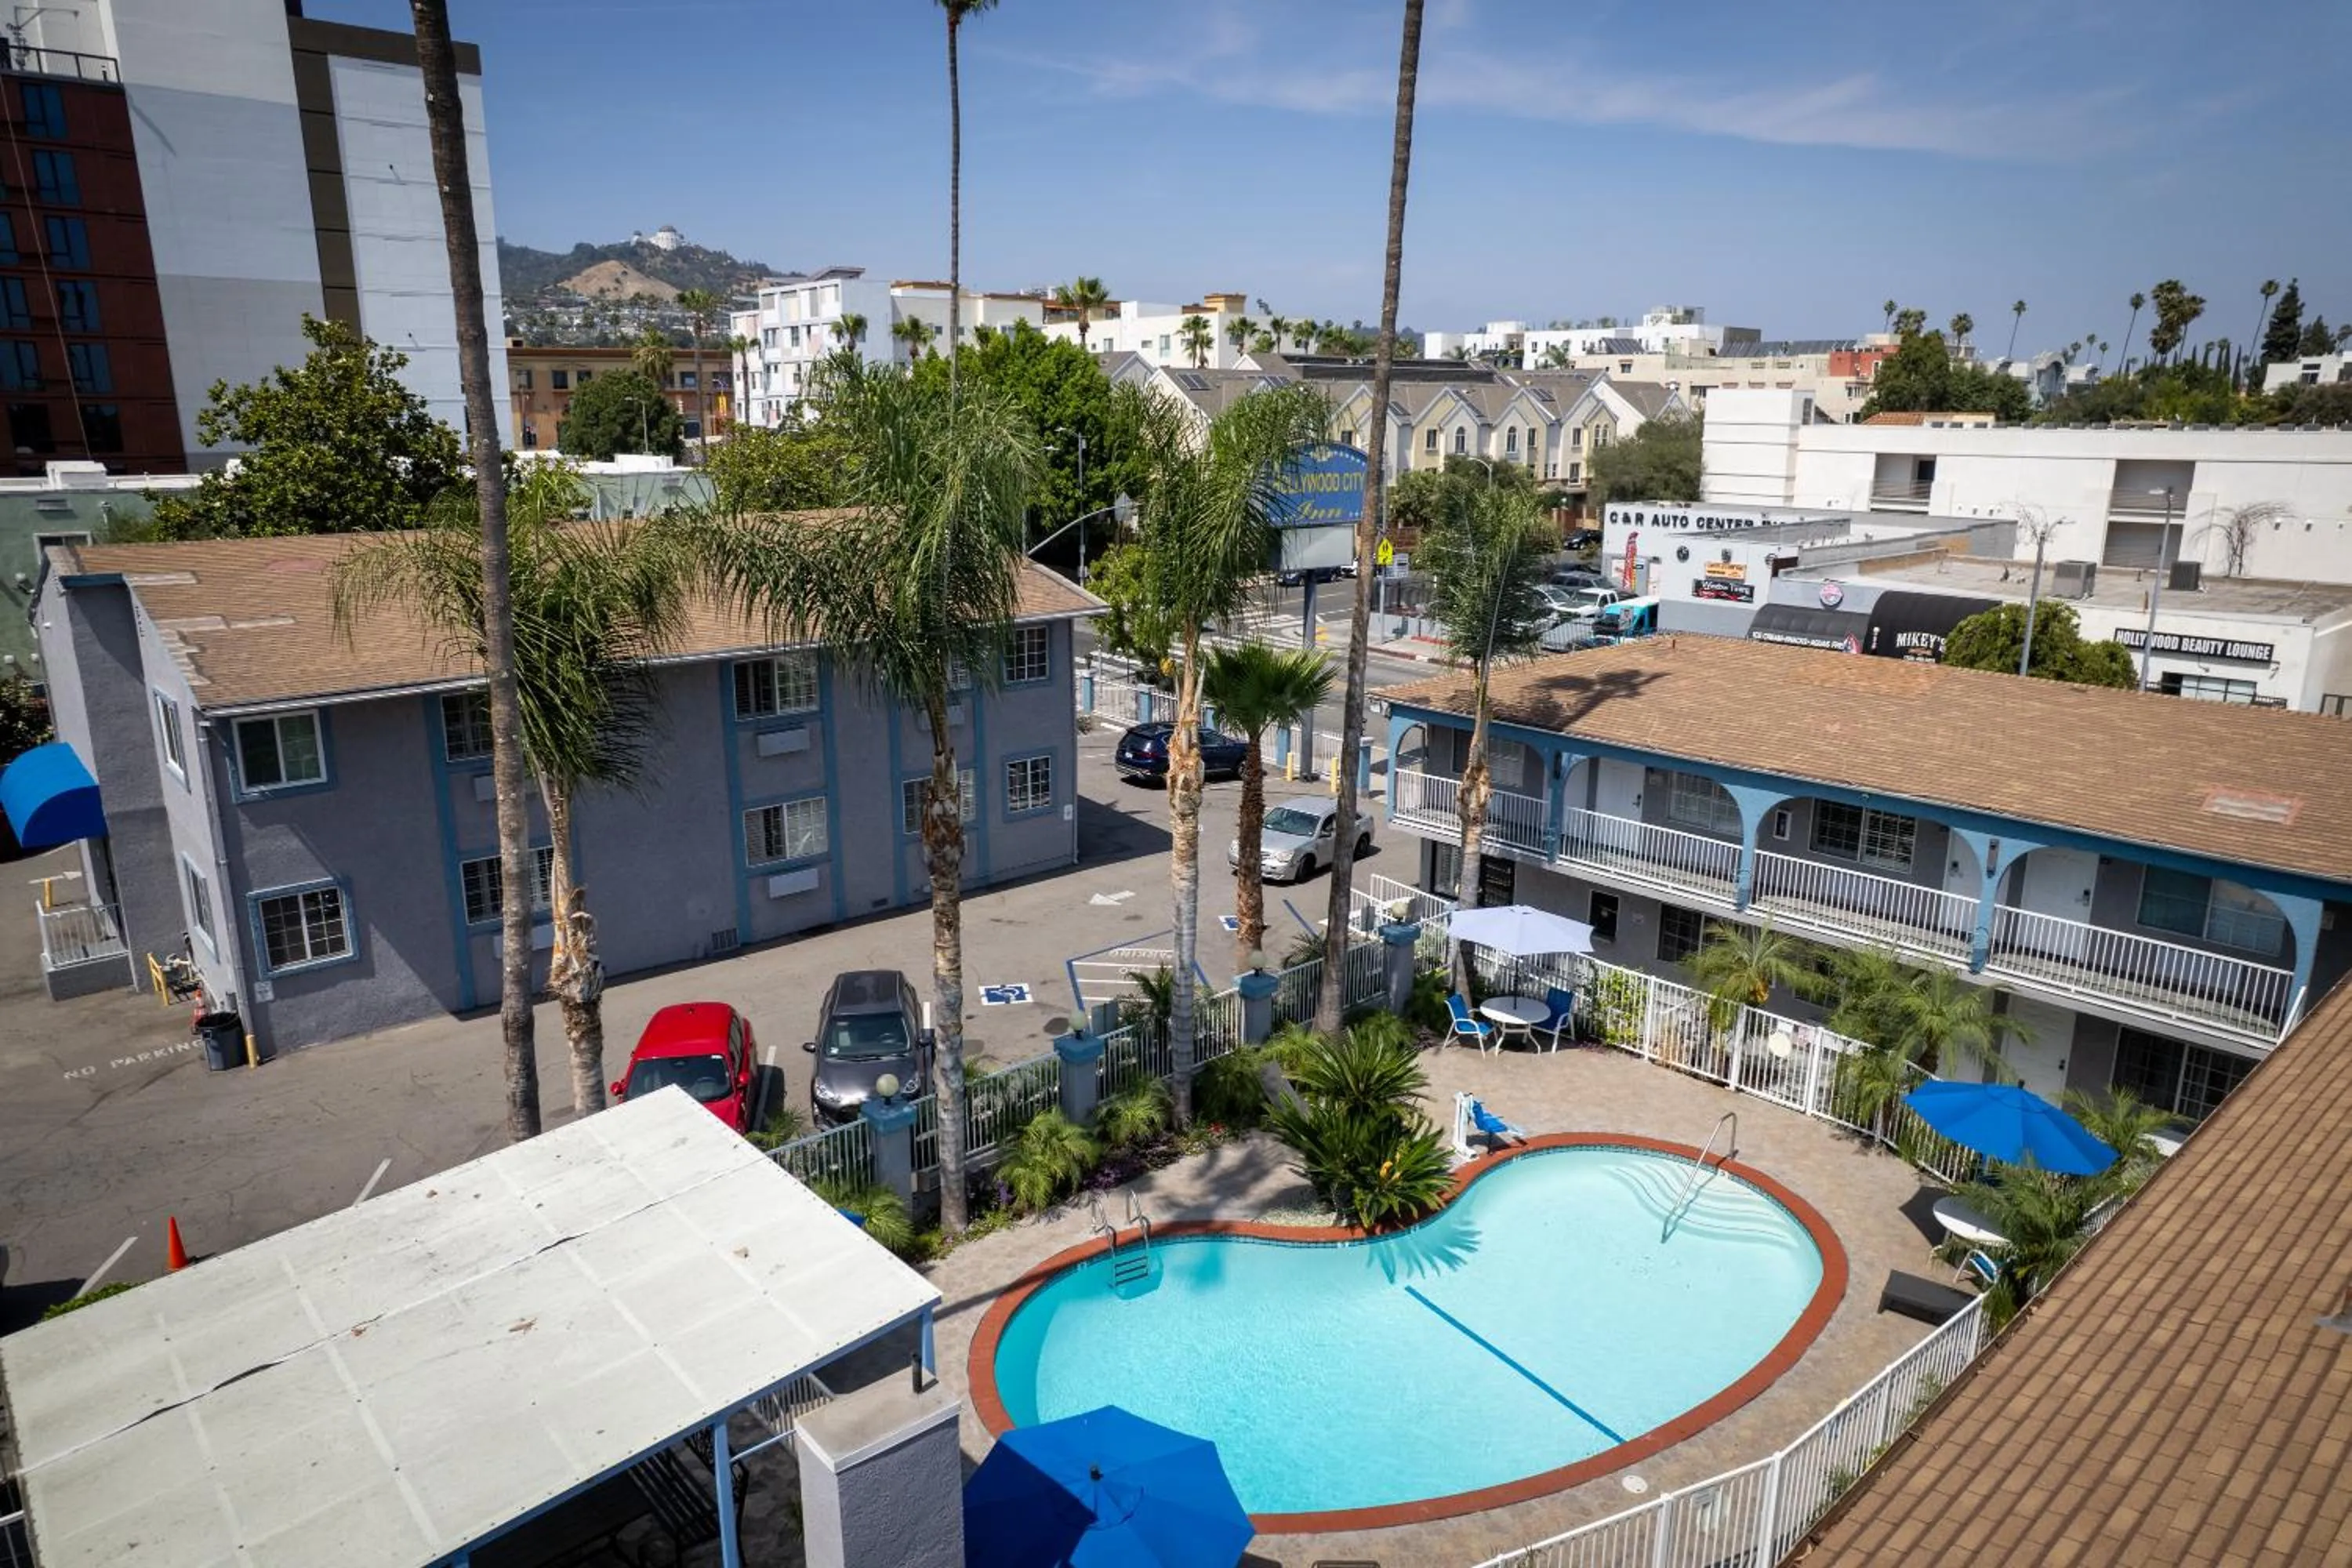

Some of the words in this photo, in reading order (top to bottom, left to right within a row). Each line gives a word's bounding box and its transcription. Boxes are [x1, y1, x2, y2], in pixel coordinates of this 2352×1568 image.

[1343, 472, 1366, 492] CITY
[1298, 499, 1341, 520] Inn
[1610, 512, 1617, 524] C
[1622, 513, 1632, 524] &
[1635, 512, 1644, 525] R
[1651, 514, 1689, 528] AUTO
[1696, 517, 1754, 529] CENTER
[1896, 631, 1947, 654] MIKEY'S
[2117, 630, 2180, 650] HOLLYWOOD
[2181, 637, 2223, 655] BEAUTY
[2226, 642, 2270, 660] LOUNGE
[64, 1065, 96, 1079] NO
[110, 1039, 201, 1069] PARKING
